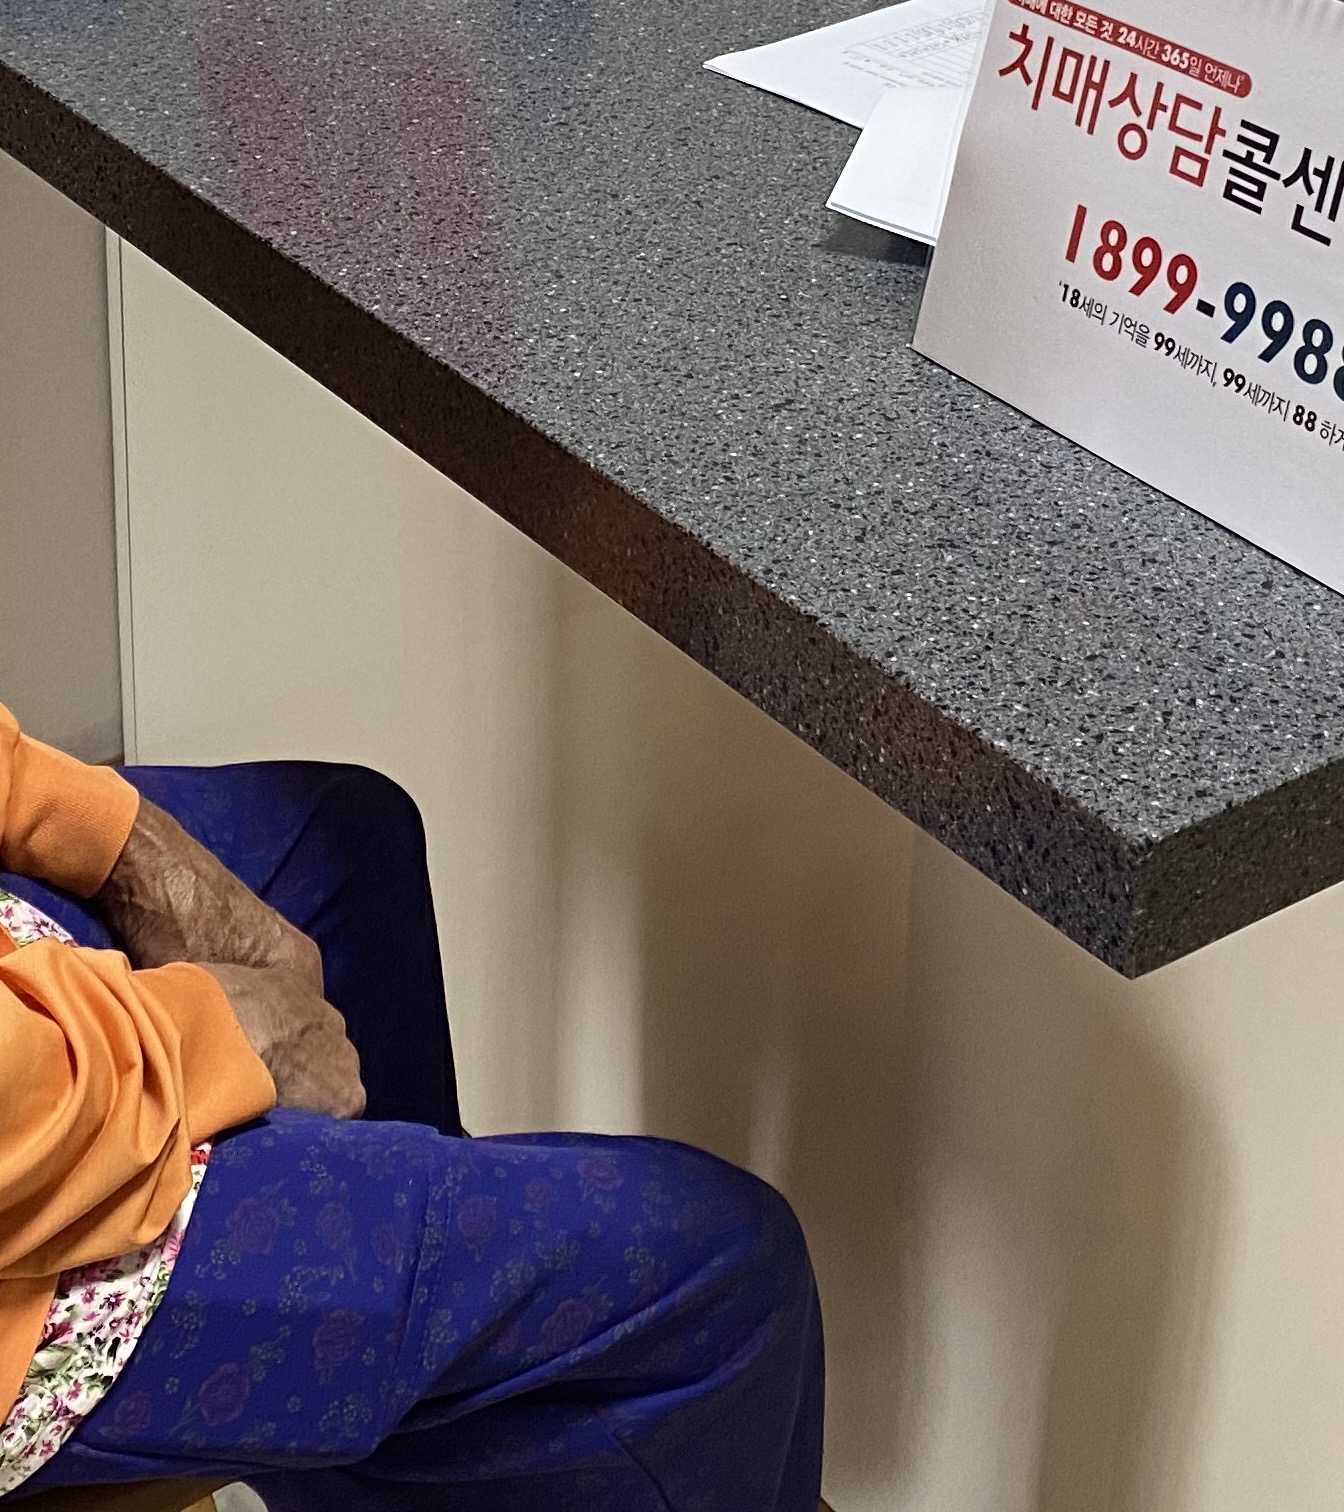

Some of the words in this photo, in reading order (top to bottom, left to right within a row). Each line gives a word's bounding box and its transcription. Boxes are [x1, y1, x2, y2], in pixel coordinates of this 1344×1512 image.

[1049, 1, 1073, 25] 대한
[1072, 9, 1099, 34] 모든
[1117, 26, 1160, 60] 24시간
[1161, 44, 1202, 77] 365일
[1108, 310, 1151, 349] 기억을
[1222, 368, 1291, 422] 99세까지
[1292, 404, 1318, 433] 88
